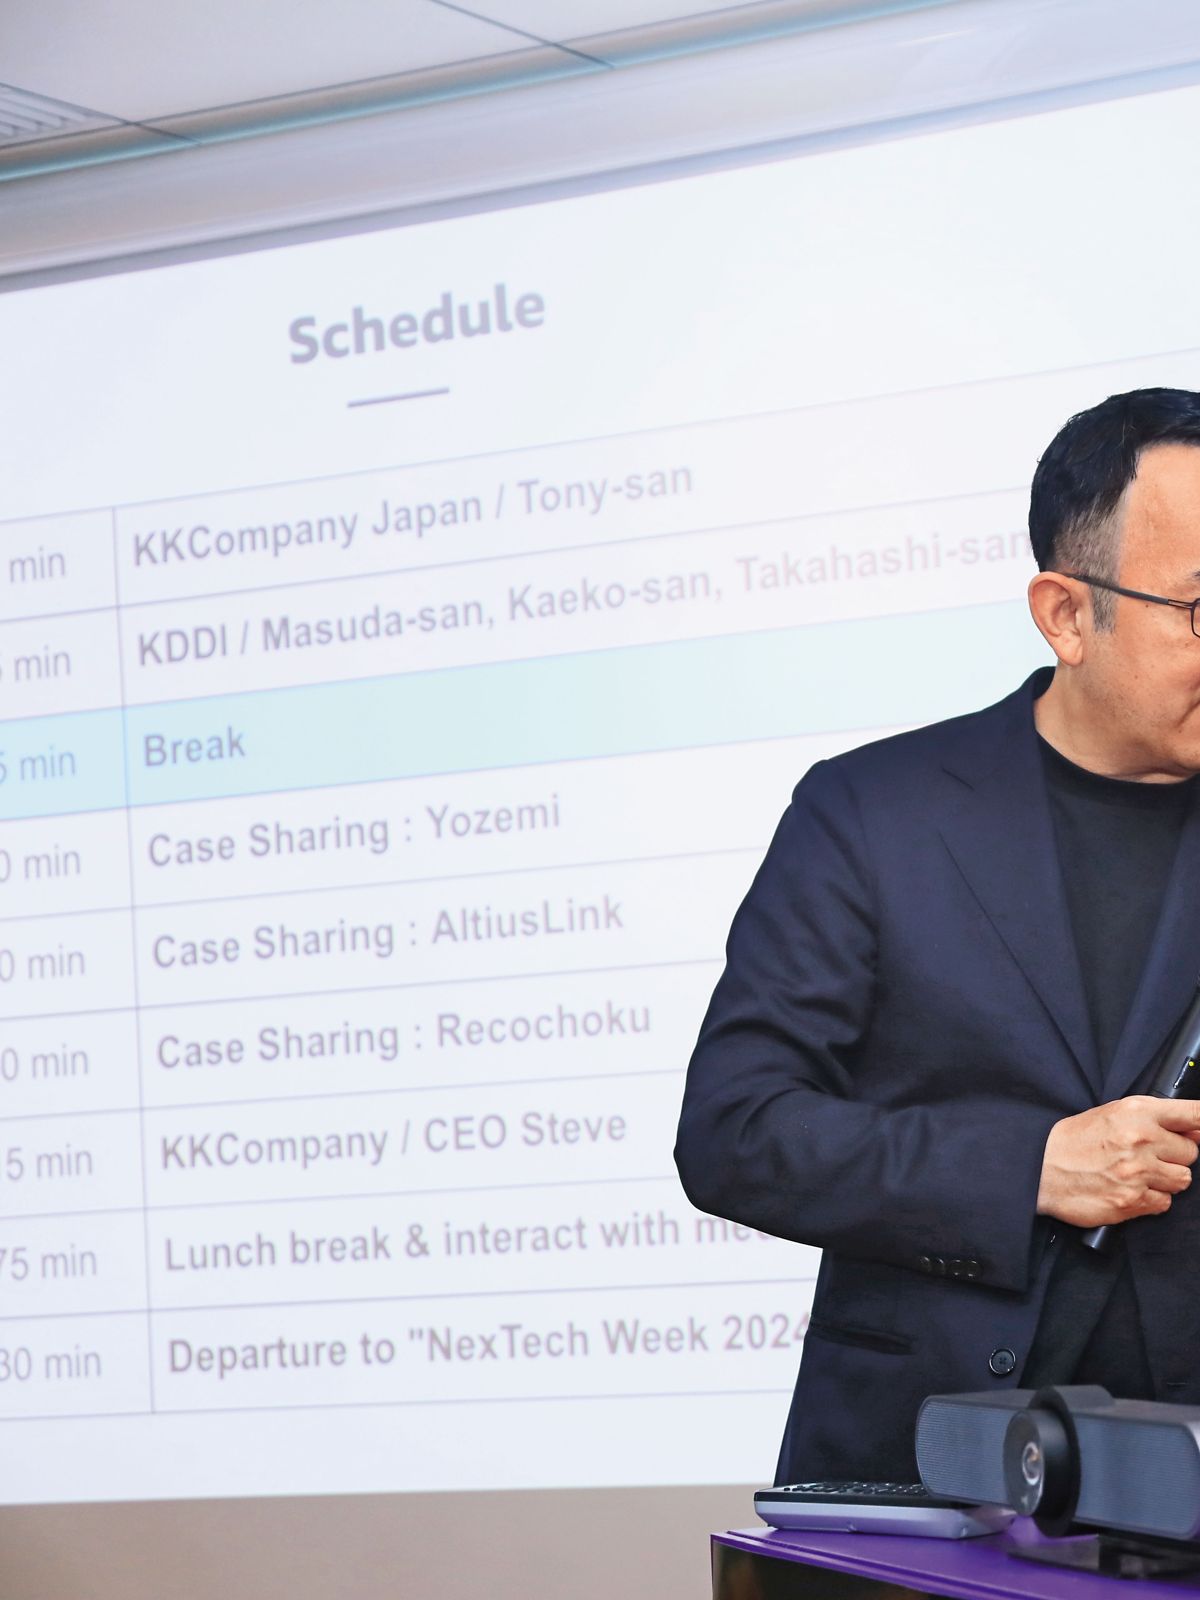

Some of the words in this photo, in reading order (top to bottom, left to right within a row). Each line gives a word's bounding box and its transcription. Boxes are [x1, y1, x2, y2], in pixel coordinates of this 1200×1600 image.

[288, 284, 544, 365] Schedule
[133, 514, 358, 567] KKCompany
[371, 496, 482, 539] Japan
[495, 483, 505, 520] /
[516, 467, 692, 515] Tony-san
[9, 546, 66, 584] min
[138, 624, 227, 666] KDDI
[240, 620, 250, 656] /
[261, 601, 494, 652] Masuda-san,
[508, 573, 721, 622] Kaeko-san,
[14, 645, 71, 682] min
[19, 745, 77, 781] min
[144, 725, 246, 768] Break
[148, 833, 235, 868] Case
[249, 815, 389, 858] Sharing
[404, 816, 412, 843] :
[425, 793, 559, 839] Yozemi
[24, 844, 81, 880] min
[152, 934, 239, 969] Case
[254, 918, 394, 960] Sharing
[409, 921, 417, 945] :
[431, 895, 623, 944] AltiusLink
[27, 944, 85, 980] min
[156, 1035, 244, 1070] Case
[258, 1021, 398, 1062] Sharing
[414, 1024, 422, 1048] :
[437, 1000, 650, 1048] Recochoku
[0, 1047, 19, 1082] 0
[31, 1043, 88, 1080] min
[161, 1131, 388, 1170] KKCompany
[401, 1120, 410, 1155] /
[423, 1114, 506, 1153] CEO
[521, 1111, 626, 1147] Steve
[6, 1147, 24, 1182] 5
[36, 1143, 93, 1179] min
[40, 1243, 97, 1279] min
[165, 1232, 276, 1272] Lunch
[290, 1226, 391, 1264] break
[404, 1223, 430, 1258] &
[444, 1217, 587, 1256] interact
[600, 1210, 679, 1248] with
[695, 1217, 778, 1242] me
[44, 1344, 102, 1379] min
[168, 1337, 346, 1380] Departure
[359, 1333, 395, 1365] to
[408, 1322, 589, 1362] "NexTech
[602, 1316, 709, 1355] Week
